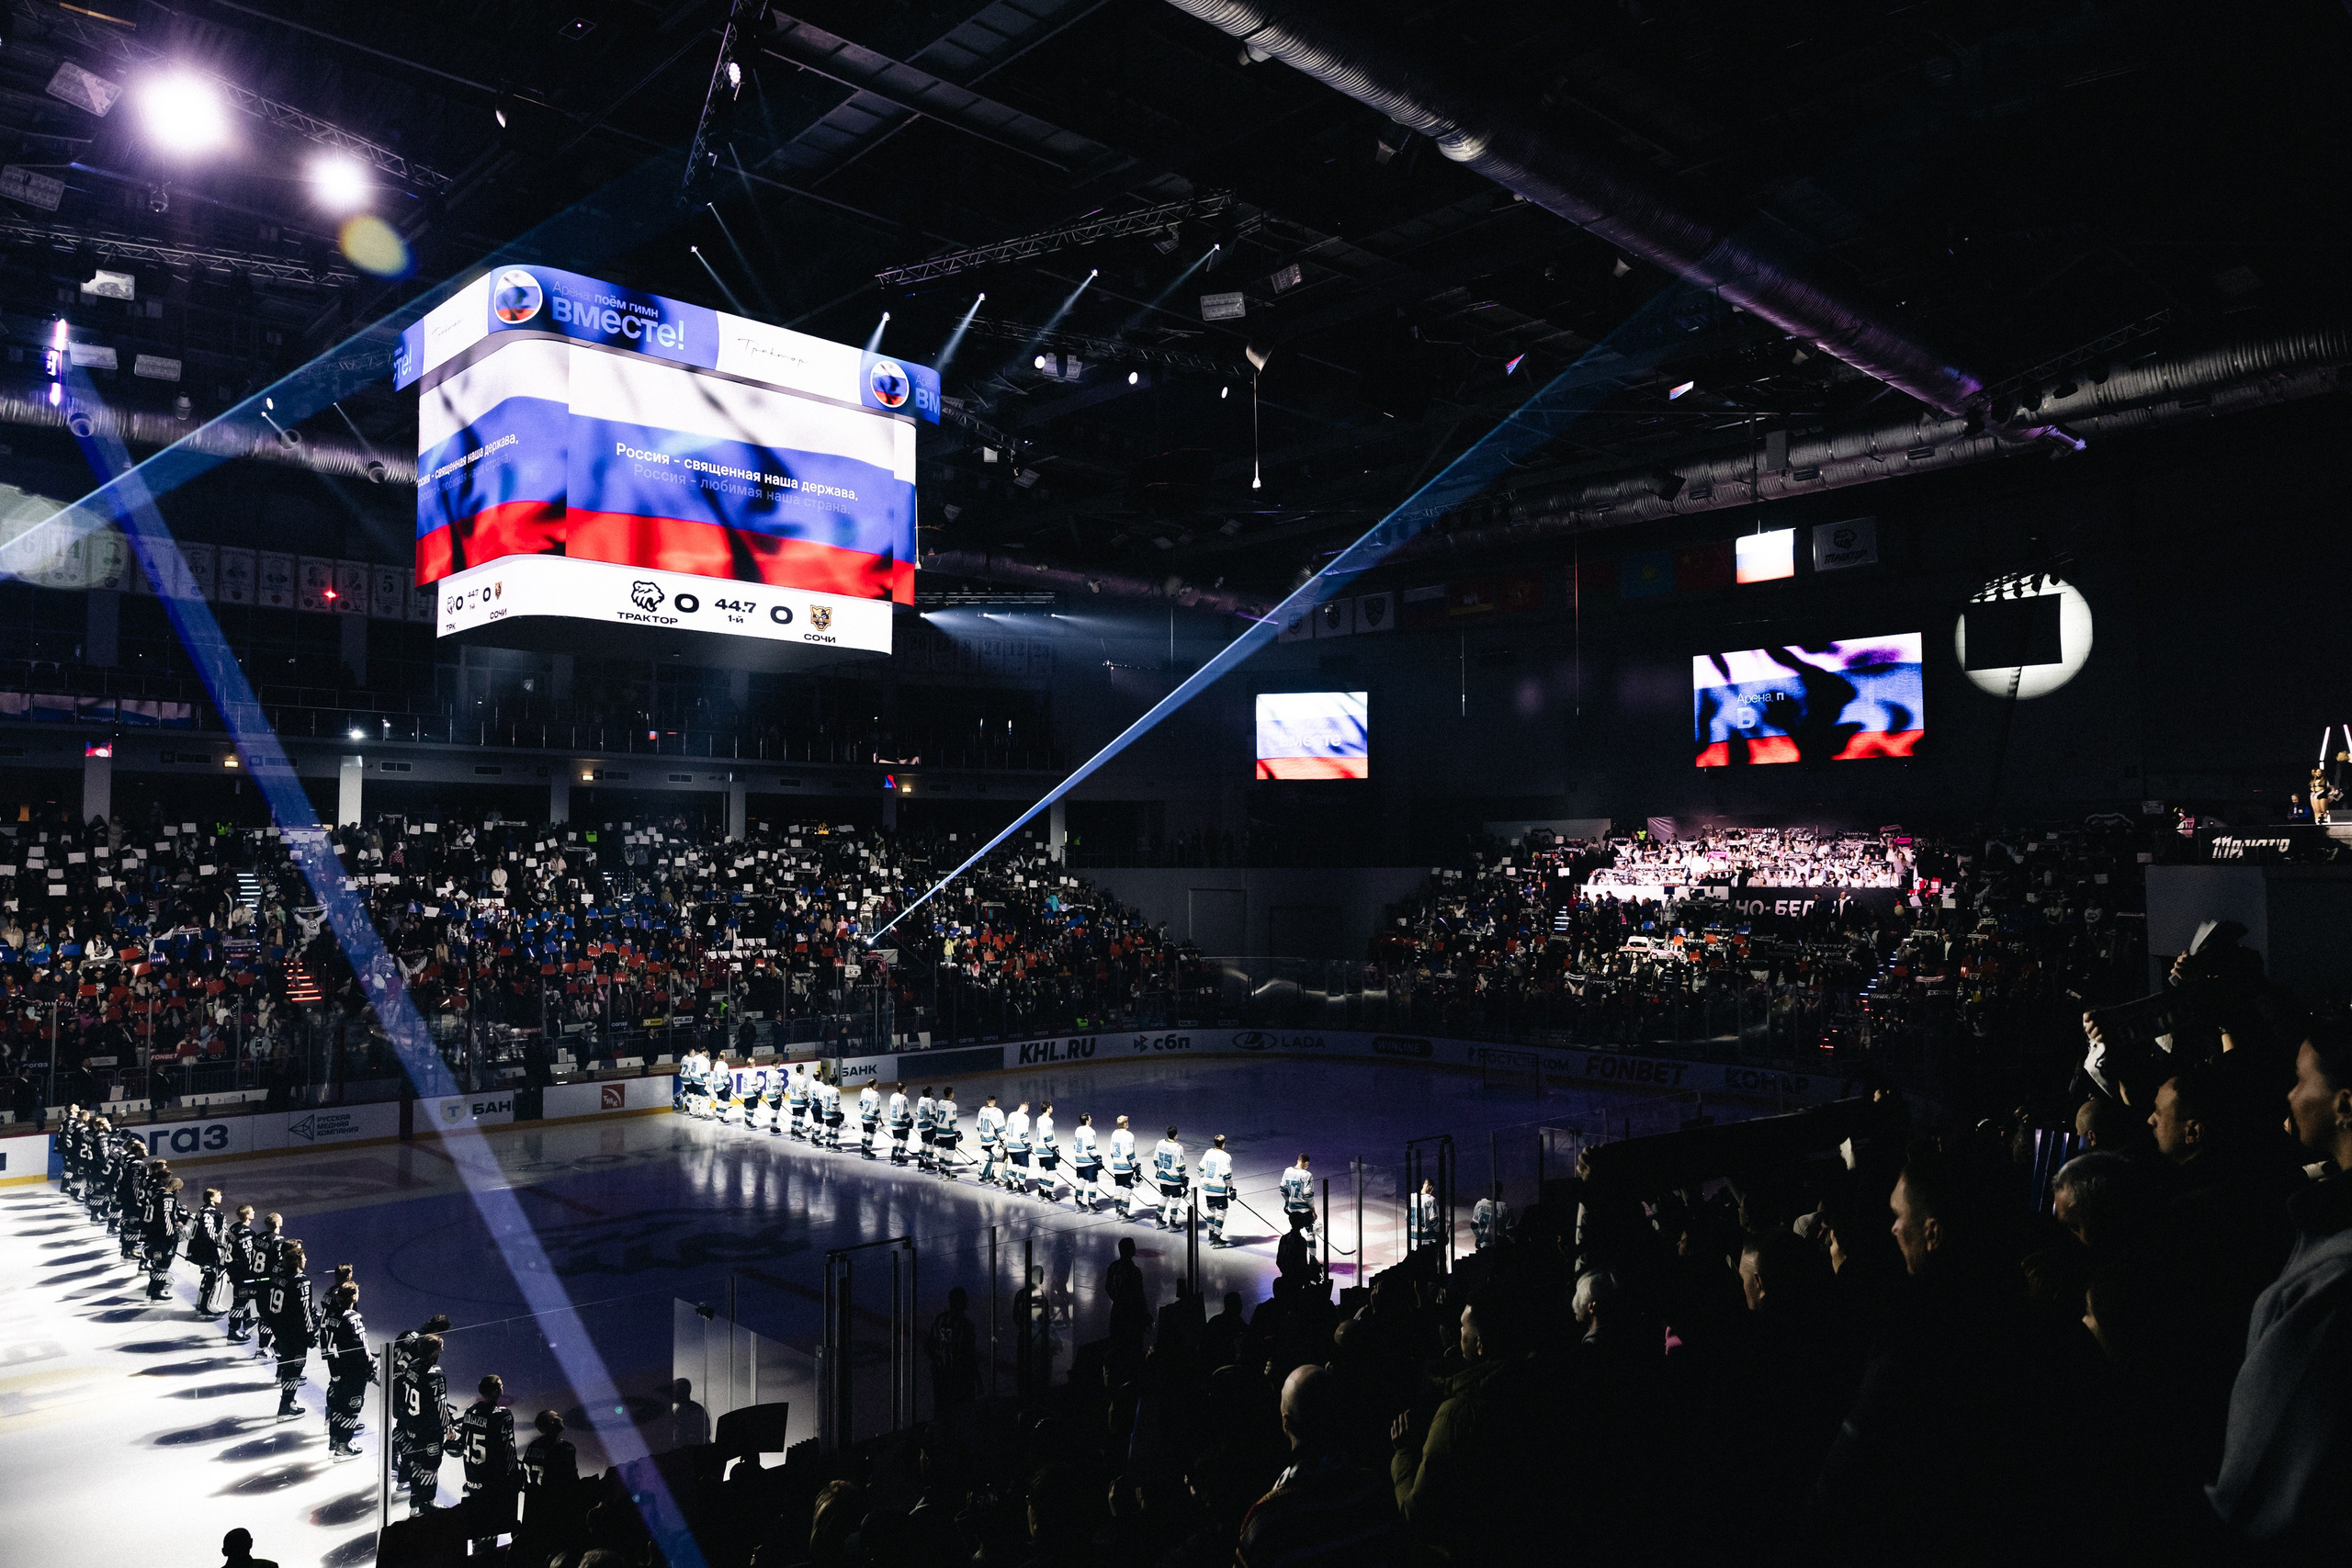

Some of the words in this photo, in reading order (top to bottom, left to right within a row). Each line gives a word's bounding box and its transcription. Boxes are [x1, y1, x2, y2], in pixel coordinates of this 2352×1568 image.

[594, 293, 627, 310] поём
[628, 302, 659, 319] гимн
[435, 456, 467, 480] священная
[467, 446, 484, 465] наша
[484, 434, 519, 458] держава,
[616, 442, 670, 466] Россия
[684, 458, 762, 483] священная
[764, 473, 798, 490] наша
[801, 481, 859, 502] держава,
[634, 464, 686, 486] Россия
[700, 479, 763, 500] любимая
[766, 490, 800, 506] наша
[804, 497, 852, 515] страна.
[456, 595, 464, 611] 0
[482, 587, 492, 603] 0
[490, 608, 507, 620] СОЧИ
[674, 593, 699, 614] 0
[714, 598, 756, 614] 44.7
[770, 605, 794, 625] 0
[616, 611, 679, 625] ТРАКТОР
[803, 633, 836, 644] СОЧИ
[1153, 1033, 1191, 1050] сбп
[1281, 1036, 1326, 1049] LADA
[151, 1053, 179, 1061] FONBET
[1019, 1037, 1096, 1065] KHL.RU
[1585, 1056, 1690, 1086] FONBET
[1725, 1066, 1810, 1095] КОНАР
[472, 1100, 514, 1115] БАН
[316, 1113, 351, 1122] РУССКАЯ
[316, 1121, 350, 1130] МЕДНАЯ
[316, 1126, 359, 1136] КОМПАНИЯ
[1158, 1152, 1173, 1169] 55
[300, 1286, 311, 1296] 19
[269, 1287, 286, 1314] 19
[432, 1382, 446, 1396] 79
